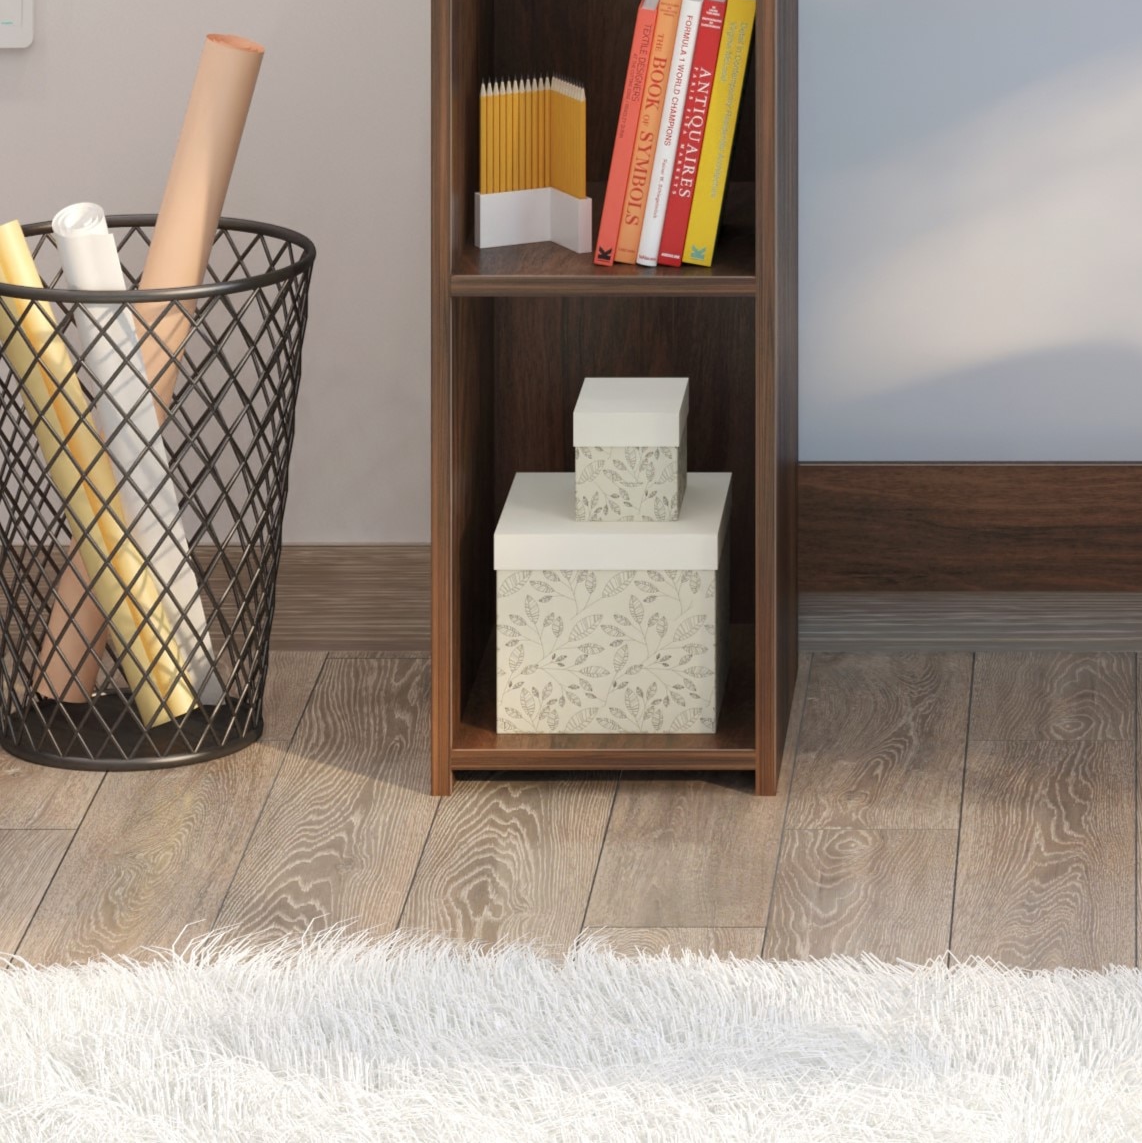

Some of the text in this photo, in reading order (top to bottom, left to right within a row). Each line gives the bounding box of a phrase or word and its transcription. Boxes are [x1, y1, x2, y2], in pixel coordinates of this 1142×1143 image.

[631, 23, 652, 102] TEXTILE DESIGNERS
[679, 14, 693, 56] FORMULA
[672, 63, 685, 95] WORLD
[624, 32, 668, 226] THE BOOK OF SYMBOLS
[663, 96, 679, 146] CHAMPIONS
[672, 66, 698, 195] PARIS FLEA MARKETS
[678, 67, 712, 198] ANTIQUAIRES
